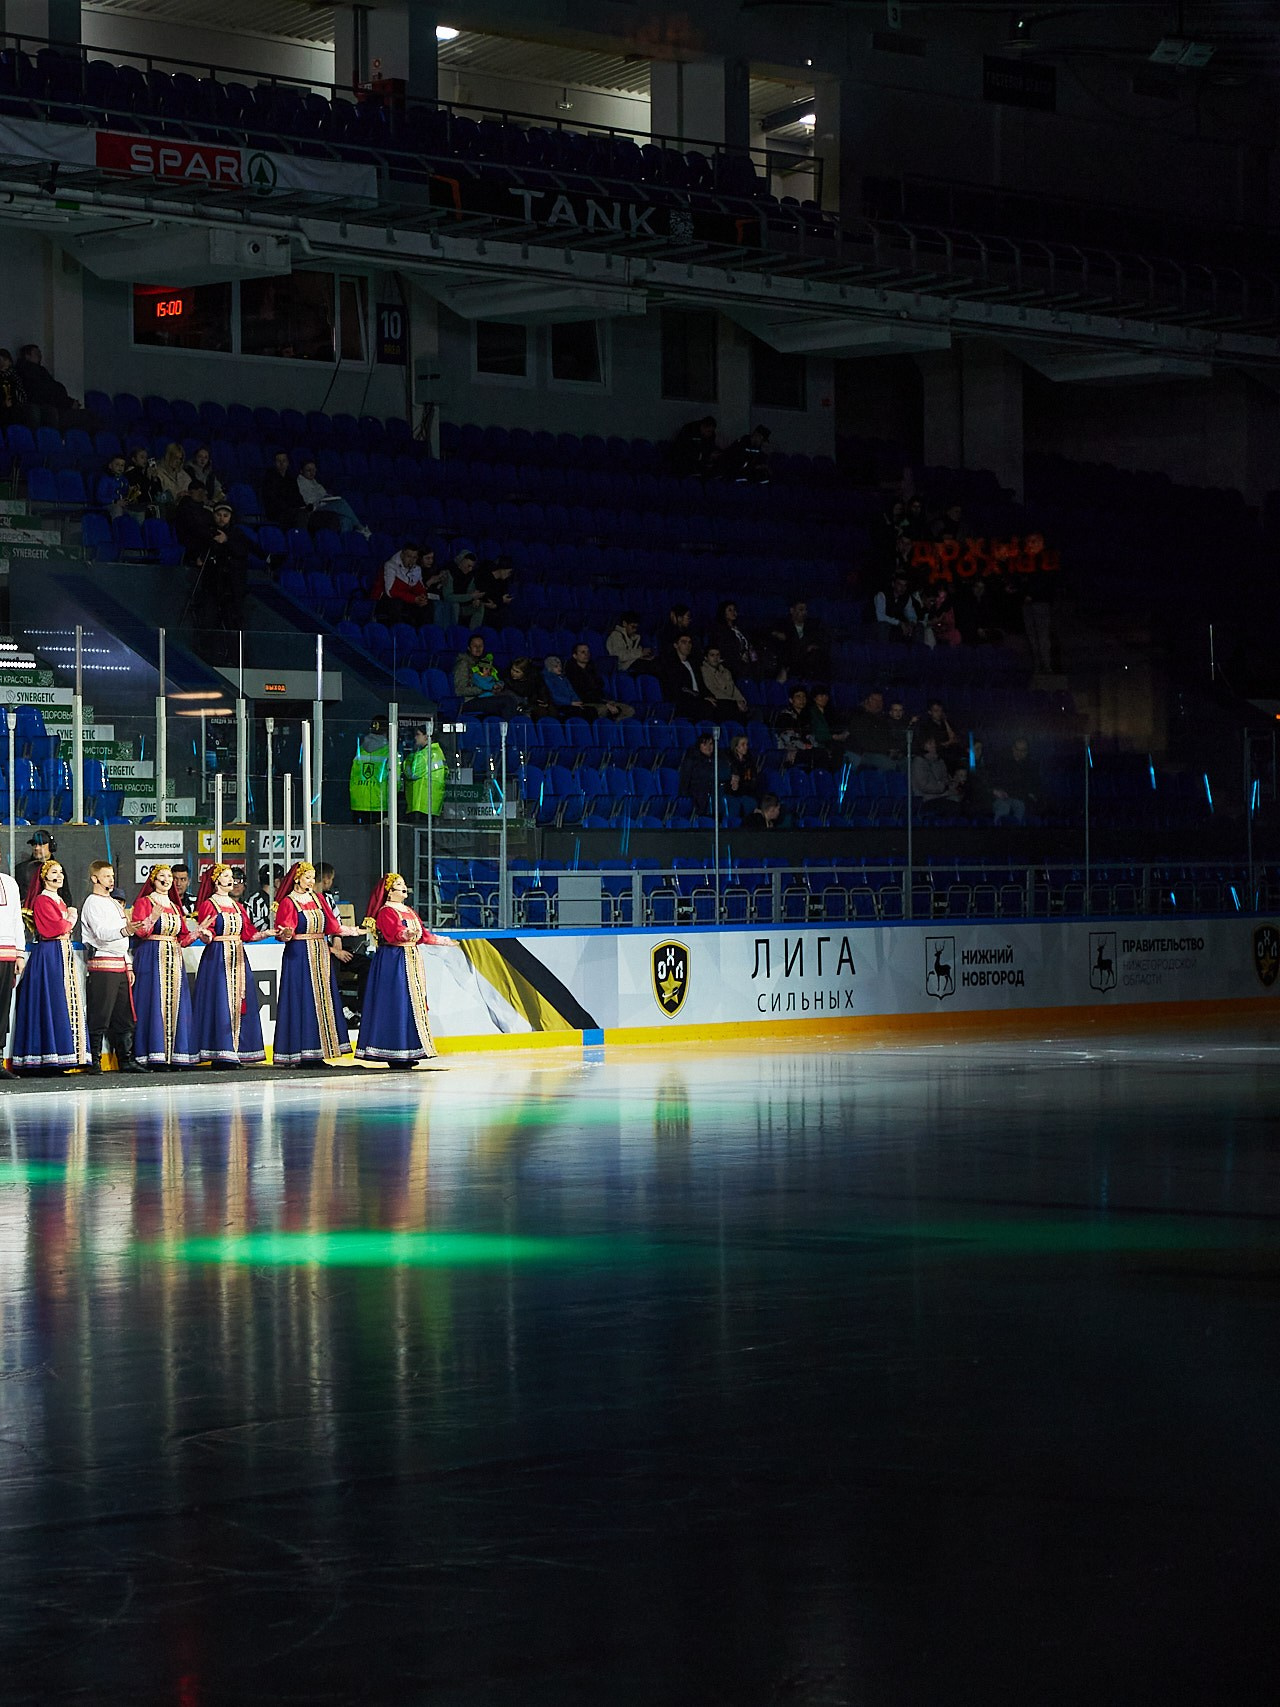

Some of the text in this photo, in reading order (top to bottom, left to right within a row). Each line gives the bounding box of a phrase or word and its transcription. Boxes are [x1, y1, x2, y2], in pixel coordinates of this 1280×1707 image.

[129, 144, 240, 183] SPAR
[507, 186, 657, 238] TANK
[155, 299, 183, 318] 15:00
[380, 310, 402, 340] 10
[12, 549, 49, 560] SYNERGETIC
[16, 692, 55, 703] SYNERGETIC
[265, 683, 287, 693] ВЫХОД
[56, 730, 96, 740] SYNEETIC
[140, 802, 178, 813] SYNEETIC
[145, 842, 181, 850] Ростелеком
[1122, 937, 1206, 953] ПРАВИТЕЛЬСТВО
[751, 935, 857, 980] ЛИГА
[961, 944, 1015, 966] НИЖНИЙ
[961, 969, 1026, 988] НОВГОРОД
[756, 989, 855, 1013] СИЛЬНЫХ
